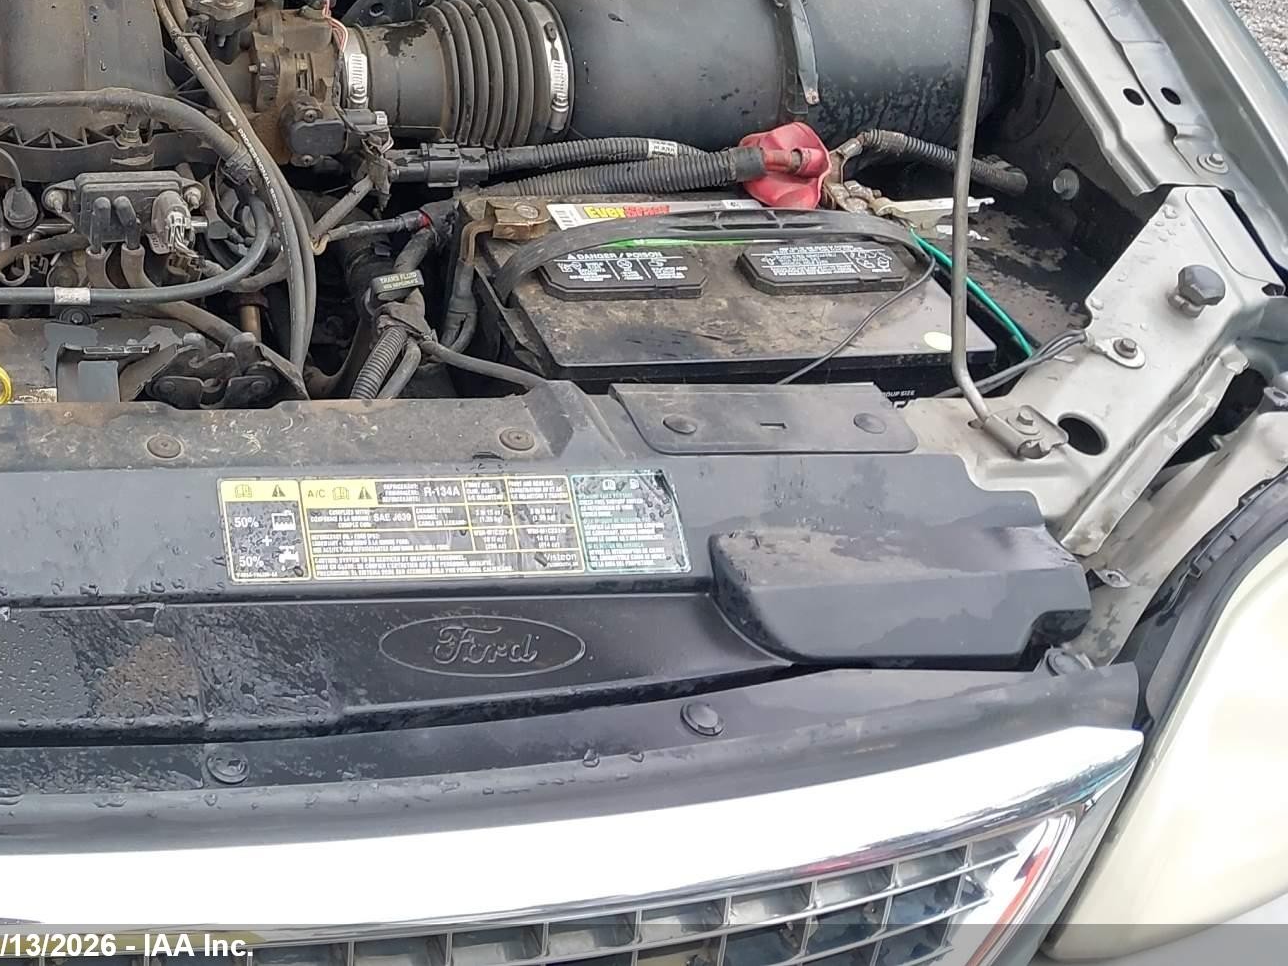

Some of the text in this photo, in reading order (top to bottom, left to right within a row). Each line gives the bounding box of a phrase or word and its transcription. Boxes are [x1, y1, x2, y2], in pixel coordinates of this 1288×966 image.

[237, 128, 272, 188] PROFESSIONAL
[575, 252, 617, 260] DANGER
[625, 251, 663, 259] POISON
[307, 489, 326, 498] A/C
[424, 485, 461, 498] R-134A
[234, 516, 259, 528] 50%
[373, 513, 391, 522] SAE
[239, 555, 264, 568] 50%
[544, 552, 577, 562] Visteon
[433, 626, 539, 664] Ford
